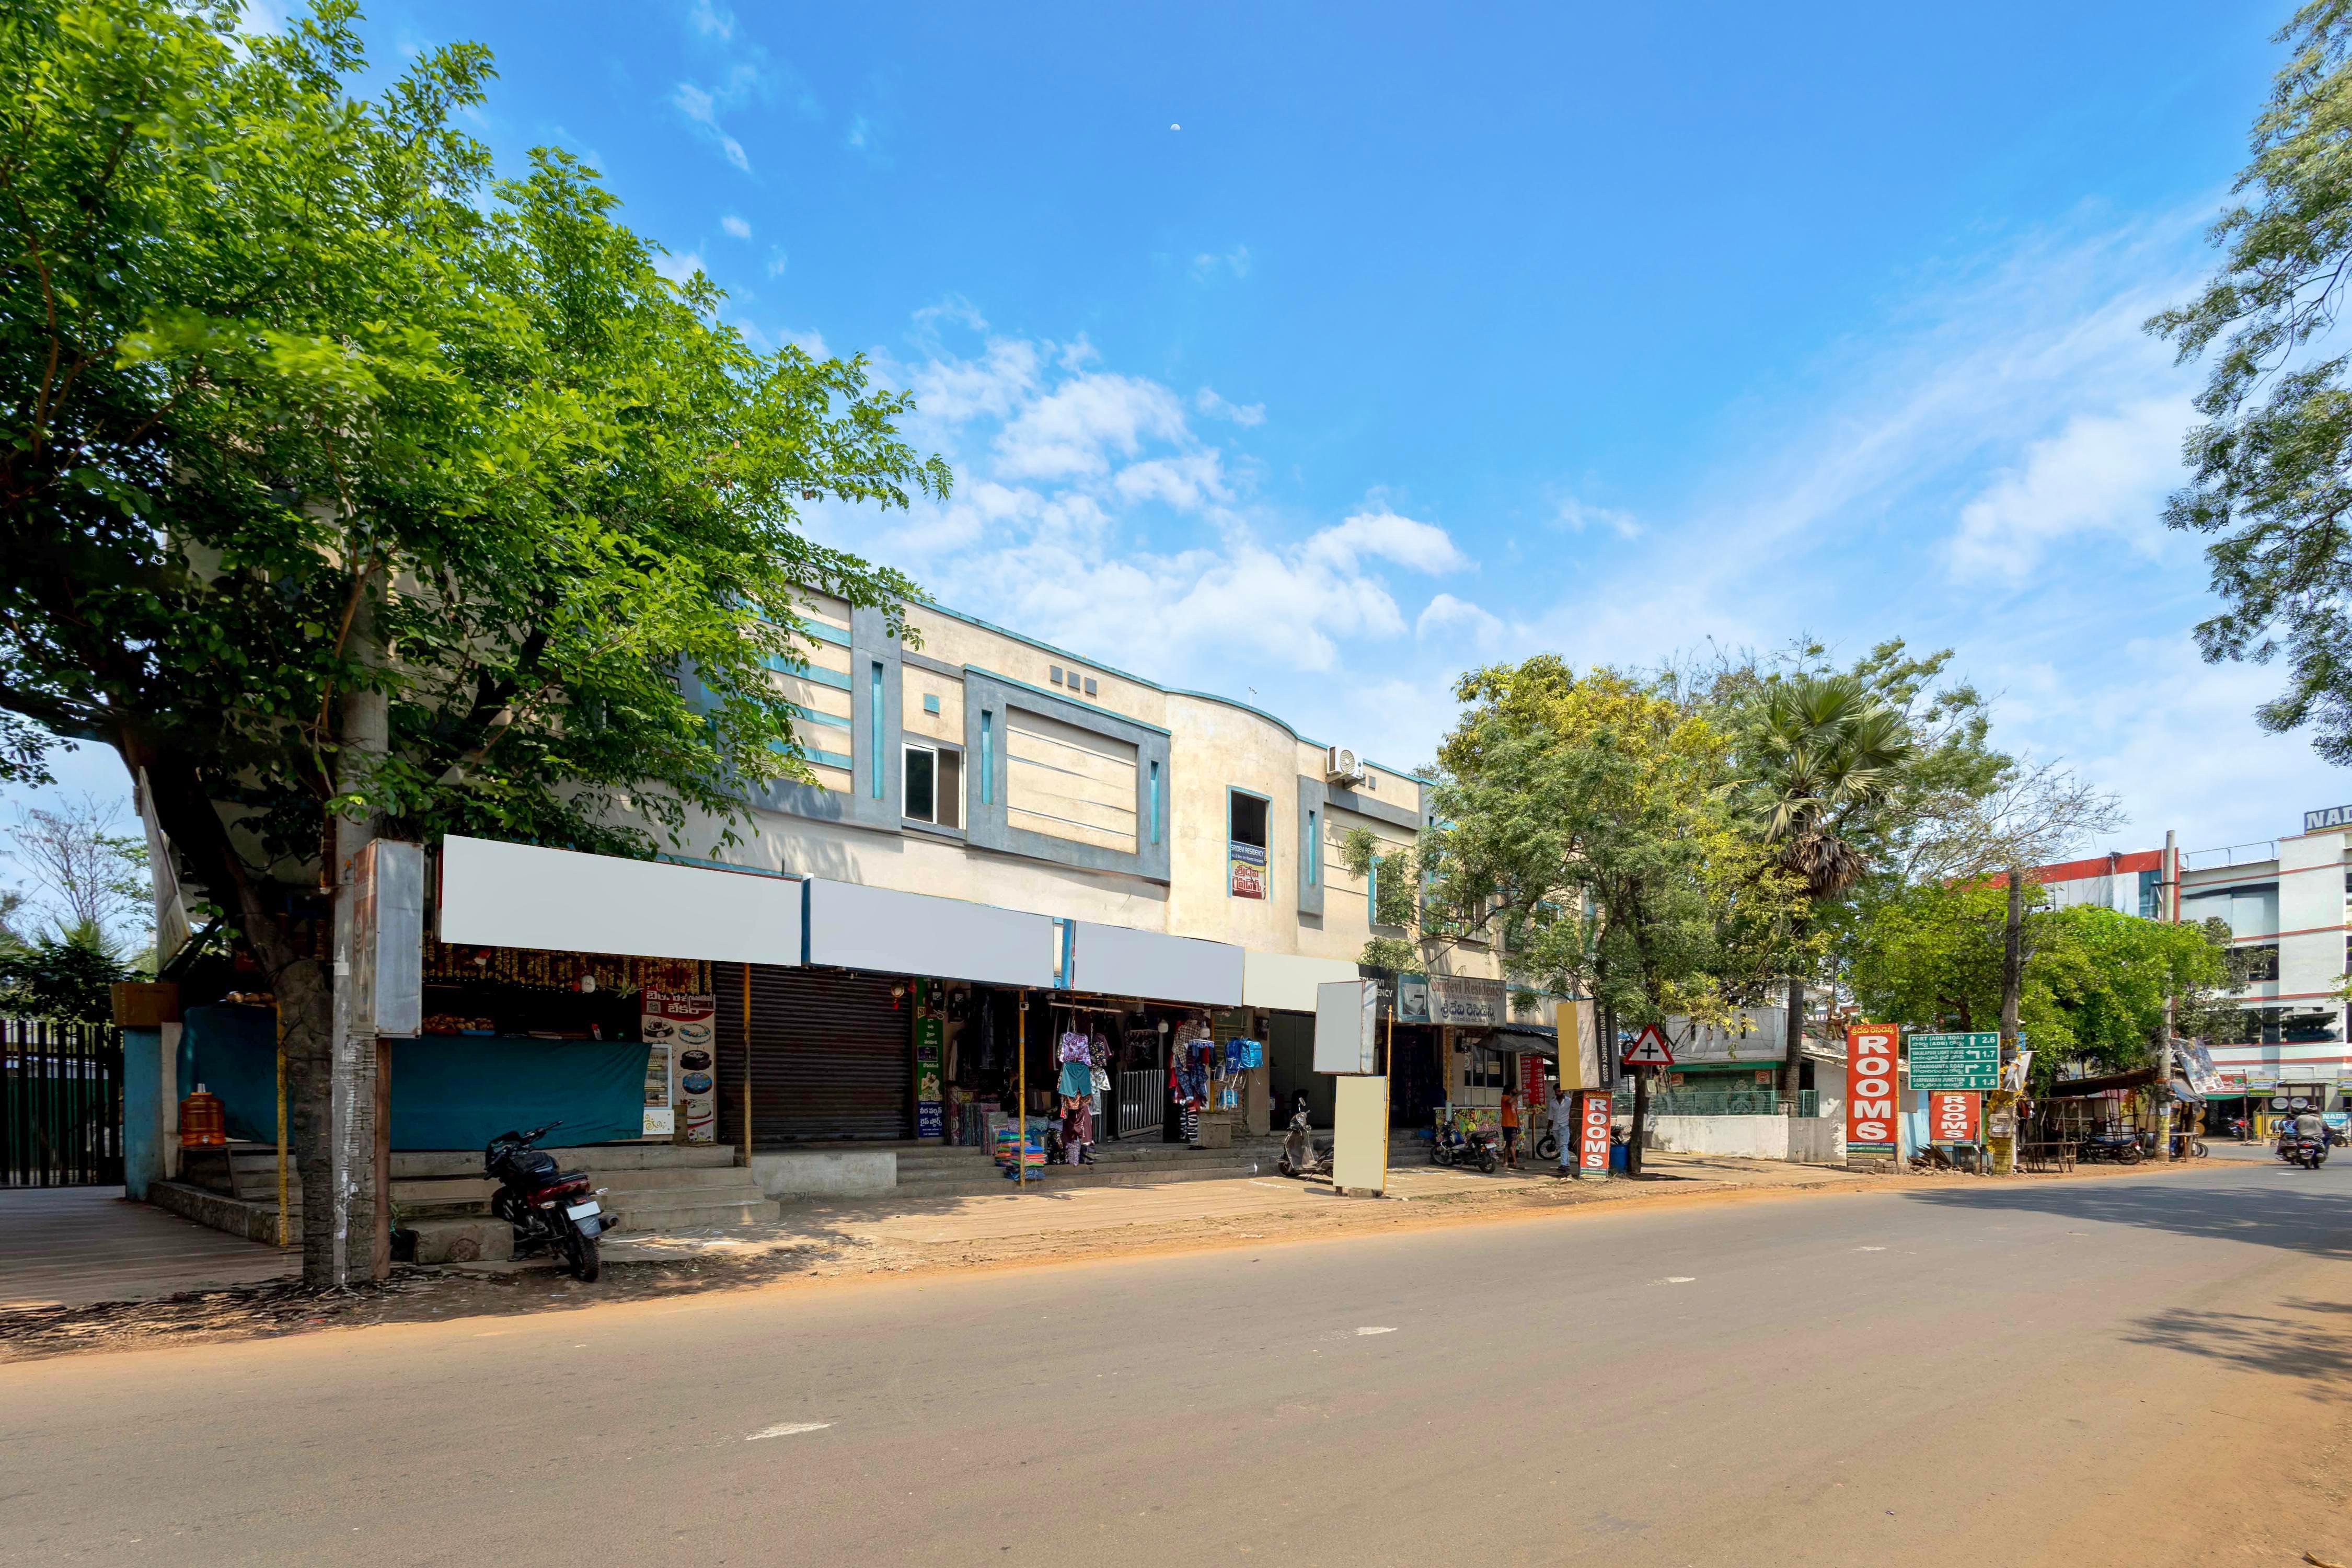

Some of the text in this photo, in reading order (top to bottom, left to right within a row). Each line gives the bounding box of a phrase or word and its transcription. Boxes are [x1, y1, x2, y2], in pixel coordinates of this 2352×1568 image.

[1230, 844, 1264, 857] SRIDEVI RESIDENCY
[1431, 977, 1504, 999] Sridevi Residency
[1440, 1000, 1464, 1019] శ్రీదేవి
[1851, 1025, 1895, 1036] శ్రీదేవి రెసిడెన్సీ
[1854, 1035, 1891, 1140] ROOMS
[1941, 1096, 1968, 1138] ROOMS
[1584, 1099, 1608, 1167] ROOMS
